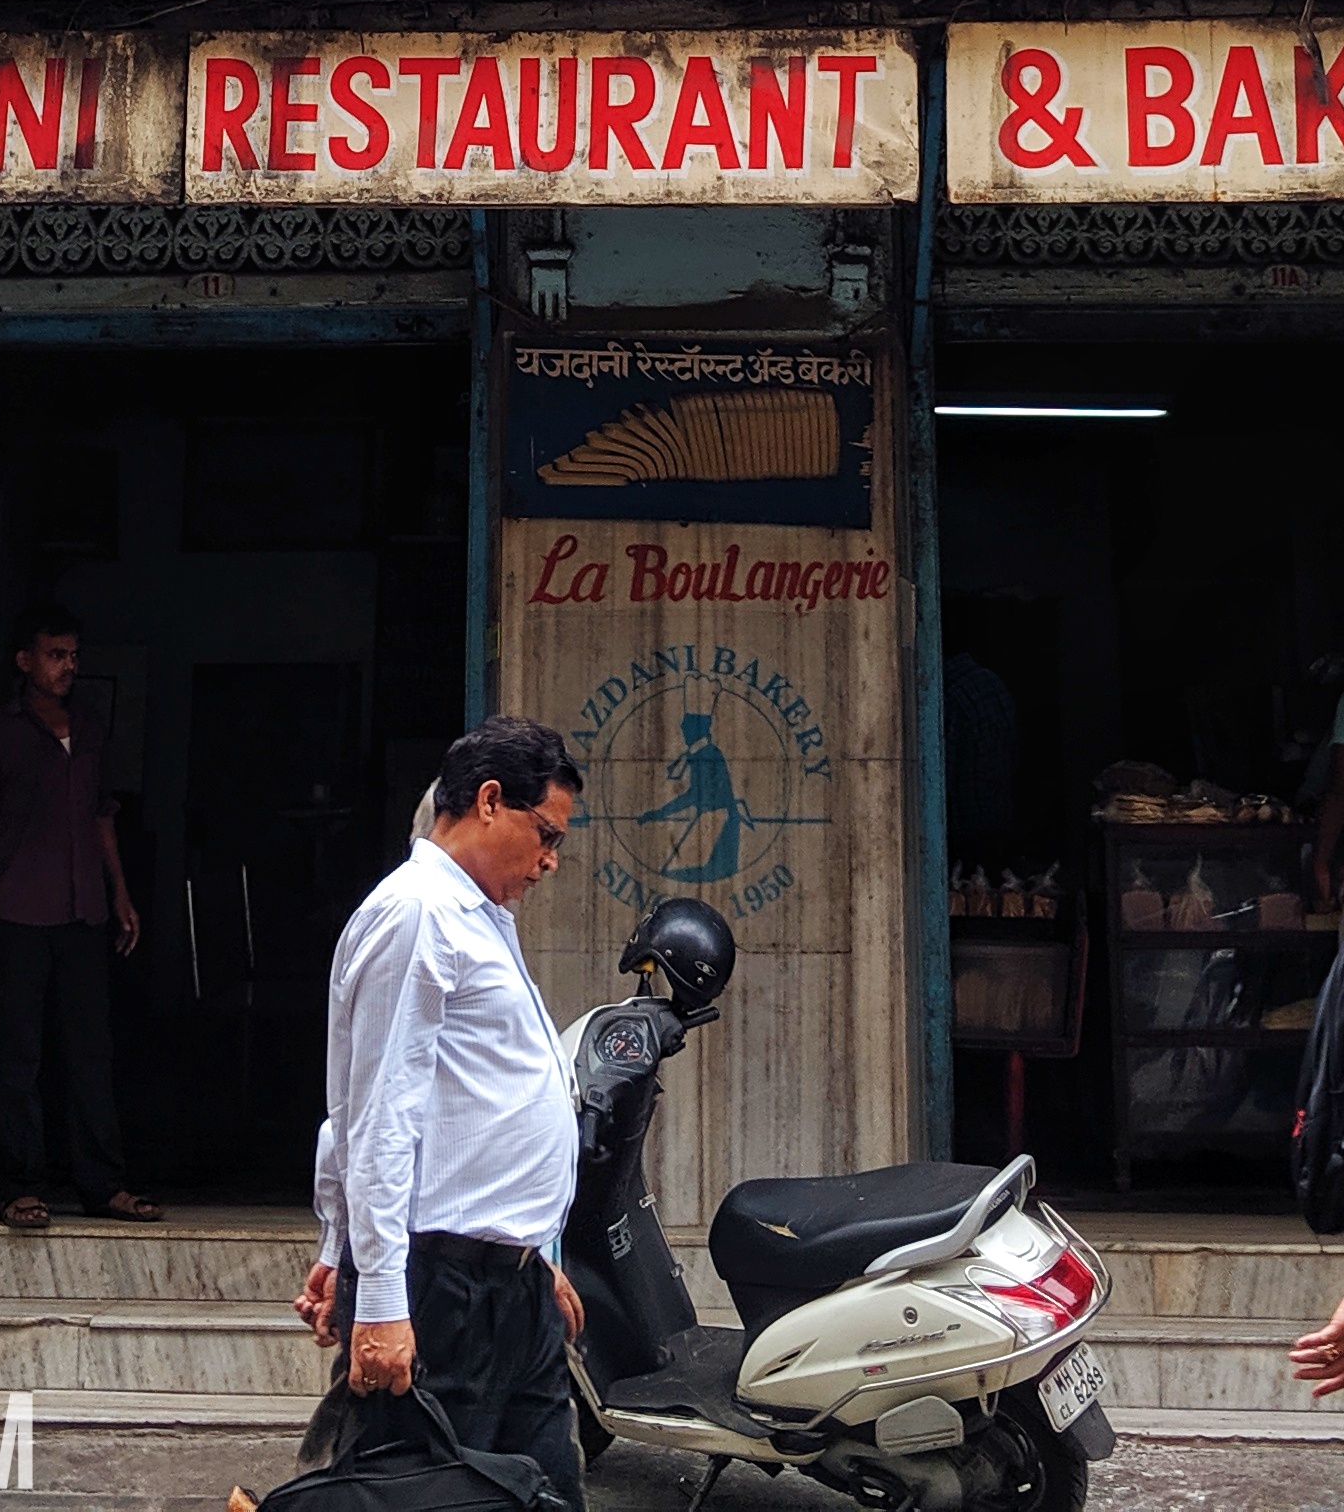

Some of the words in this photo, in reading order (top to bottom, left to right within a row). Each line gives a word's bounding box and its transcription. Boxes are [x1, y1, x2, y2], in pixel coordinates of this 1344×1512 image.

[202, 54, 877, 173] RESTAURANT
[999, 48, 1097, 171] &
[527, 535, 609, 605] La
[570, 644, 696, 773] AZDANI
[712, 645, 833, 783] BAKERY
[1073, 1366, 1104, 1405] 6289
